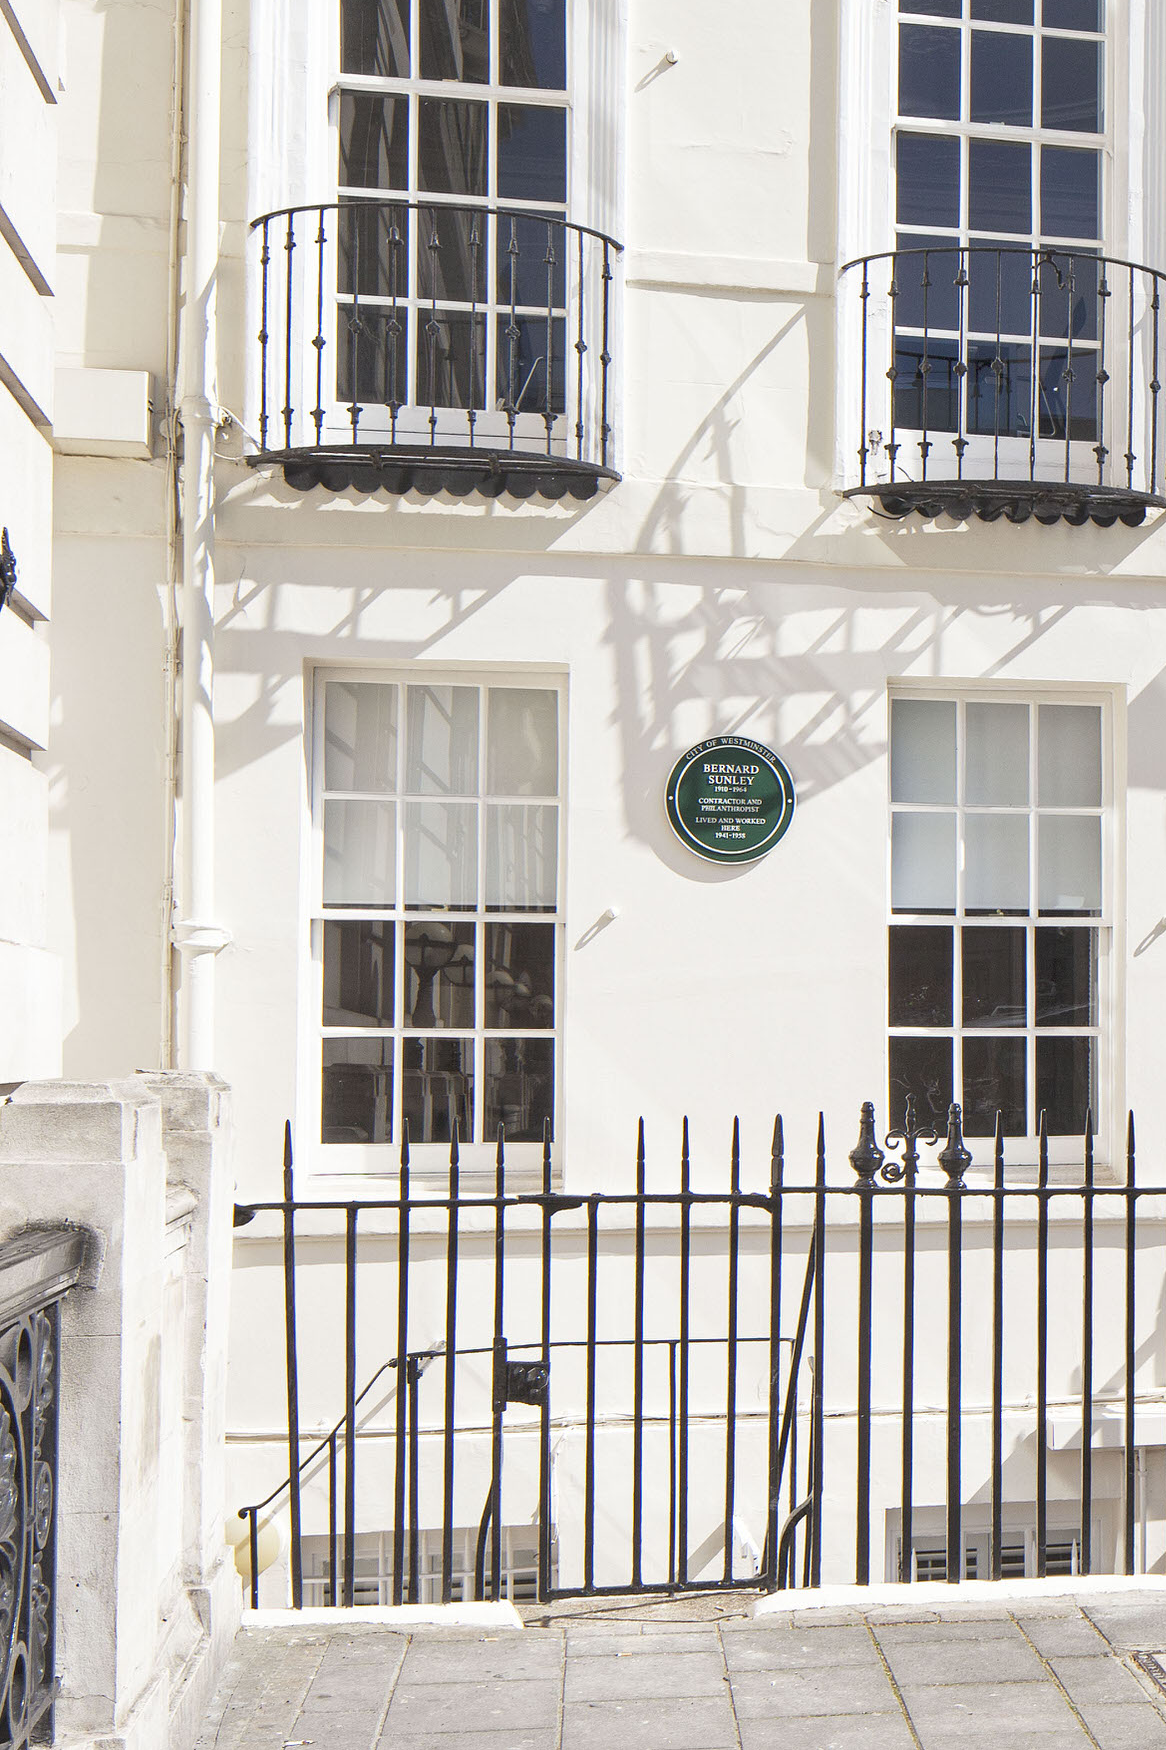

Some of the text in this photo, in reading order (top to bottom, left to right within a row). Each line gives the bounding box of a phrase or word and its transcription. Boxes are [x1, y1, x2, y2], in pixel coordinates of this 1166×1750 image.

[686, 737, 776, 764] CITY OF WESTMINSTER
[703, 763, 760, 775] BERNARD
[708, 775, 755, 786] SUNLEY
[698, 797, 763, 806] CONTRACTOR AND
[701, 805, 760, 813] PHILANTHROPIST
[695, 816, 717, 824] LIVED
